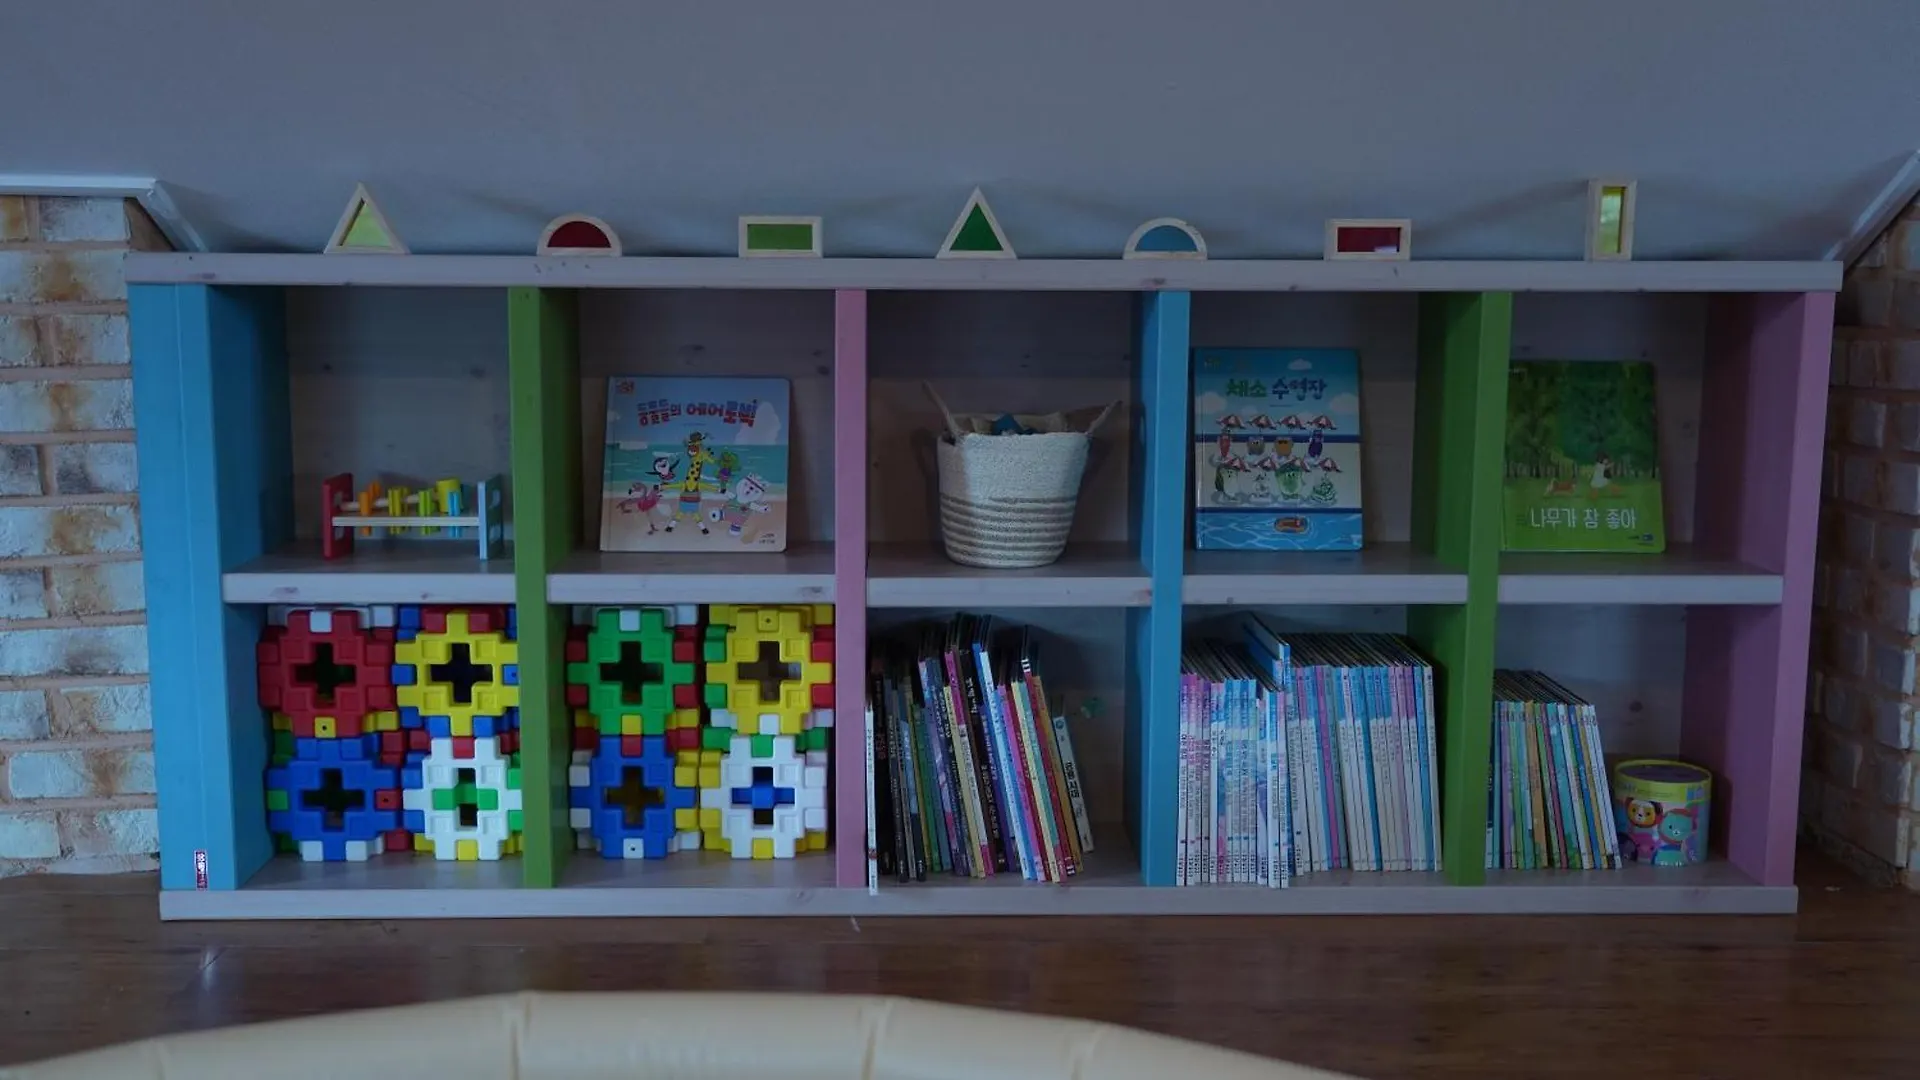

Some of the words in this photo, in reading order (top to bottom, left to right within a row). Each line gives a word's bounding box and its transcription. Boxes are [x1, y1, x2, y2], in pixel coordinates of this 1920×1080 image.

[1271, 376, 1327, 401] 수영장
[1530, 508, 1577, 530] 나무가
[1583, 508, 1599, 529] 참
[1606, 508, 1636, 529] 좋아
